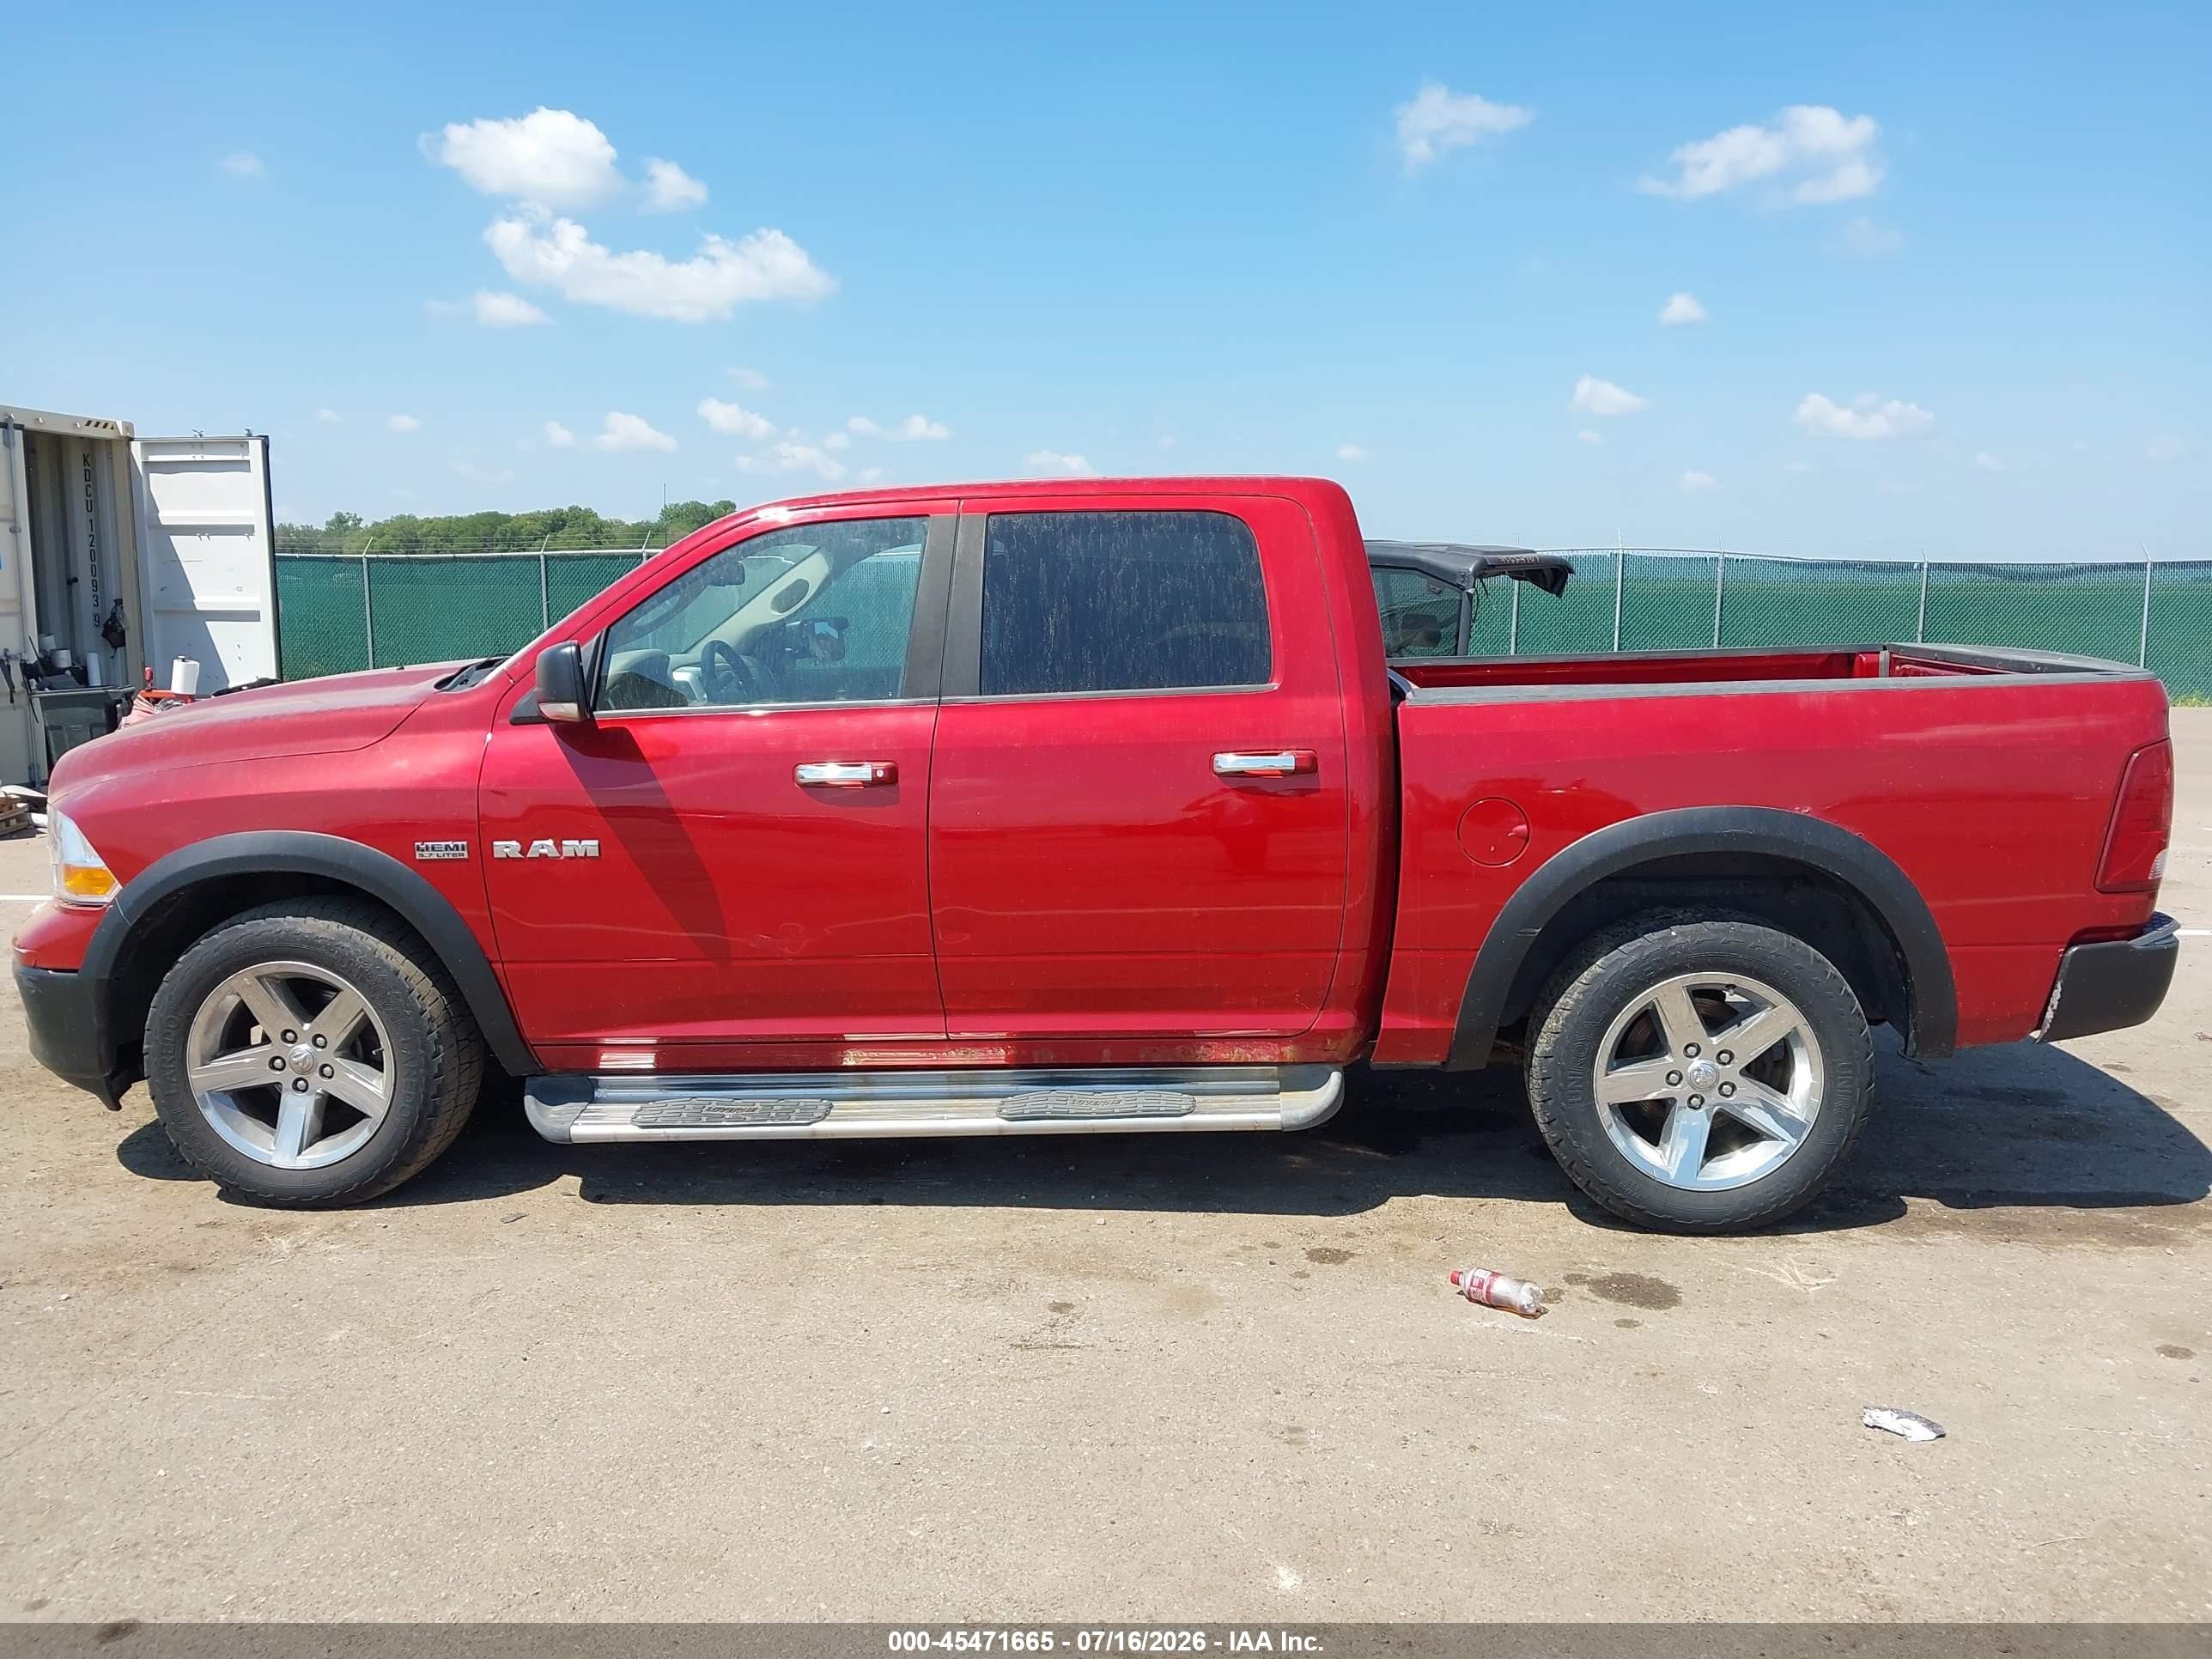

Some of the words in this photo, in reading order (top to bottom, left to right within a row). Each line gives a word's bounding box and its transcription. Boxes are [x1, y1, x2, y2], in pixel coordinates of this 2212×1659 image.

[83, 453, 93, 514] KDCU
[88, 519, 99, 608] 120093
[94, 613, 100, 627] 9
[416, 843, 466, 852] HEMI
[493, 838, 599, 859] RAM
[1566, 1005, 1608, 1105] UNIROYAL
